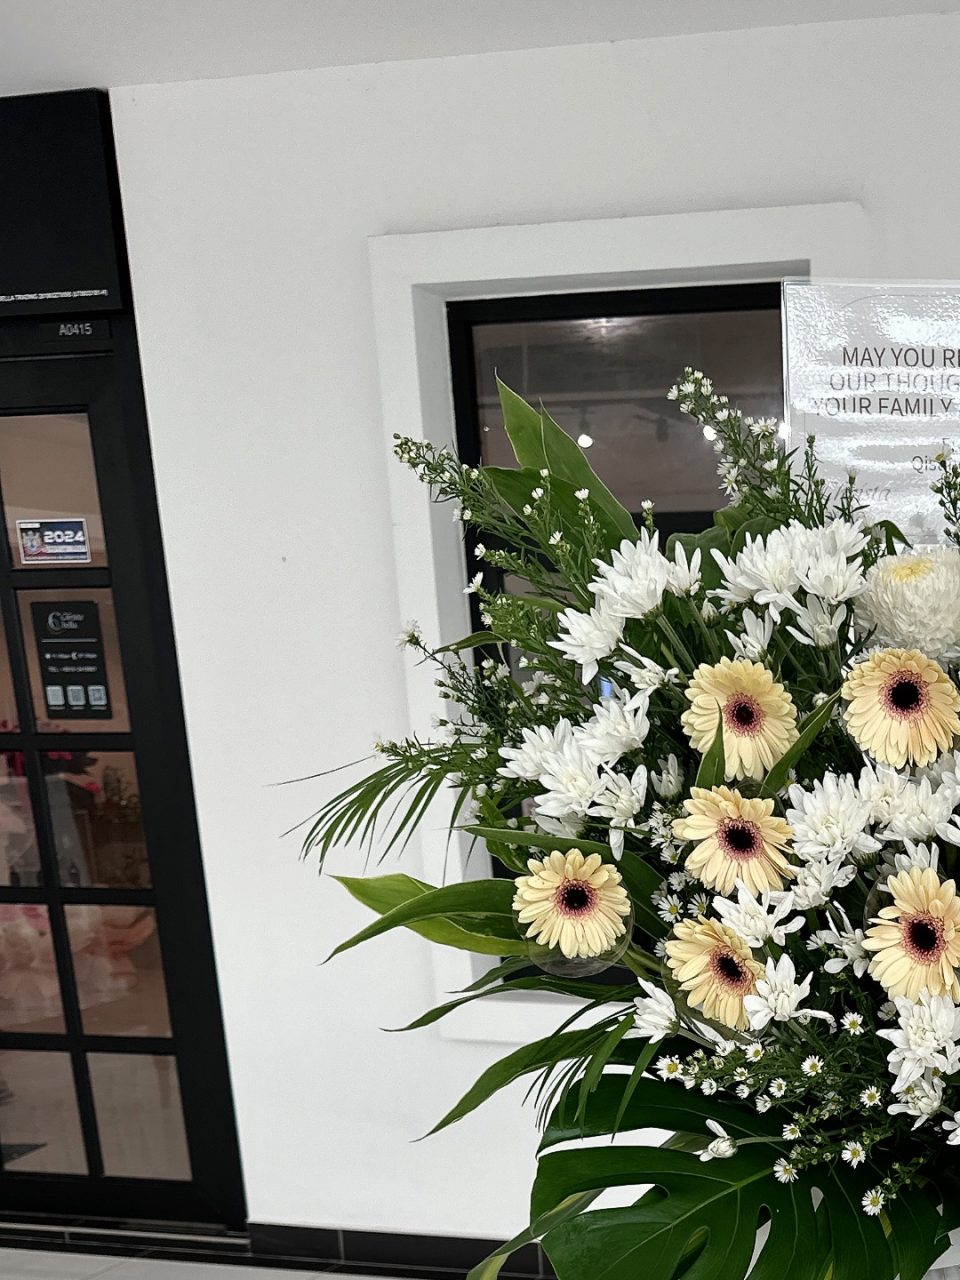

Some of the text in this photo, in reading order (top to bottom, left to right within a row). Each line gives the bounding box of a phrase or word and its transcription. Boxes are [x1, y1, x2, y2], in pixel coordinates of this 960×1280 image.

[59, 323, 92, 336] A0415
[843, 347, 886, 367] MAY
[890, 348, 935, 368] YOU
[830, 373, 875, 391] OUR
[813, 398, 872, 416] YOUR
[879, 398, 953, 417] FAMILY
[44, 530, 85, 543] 2024
